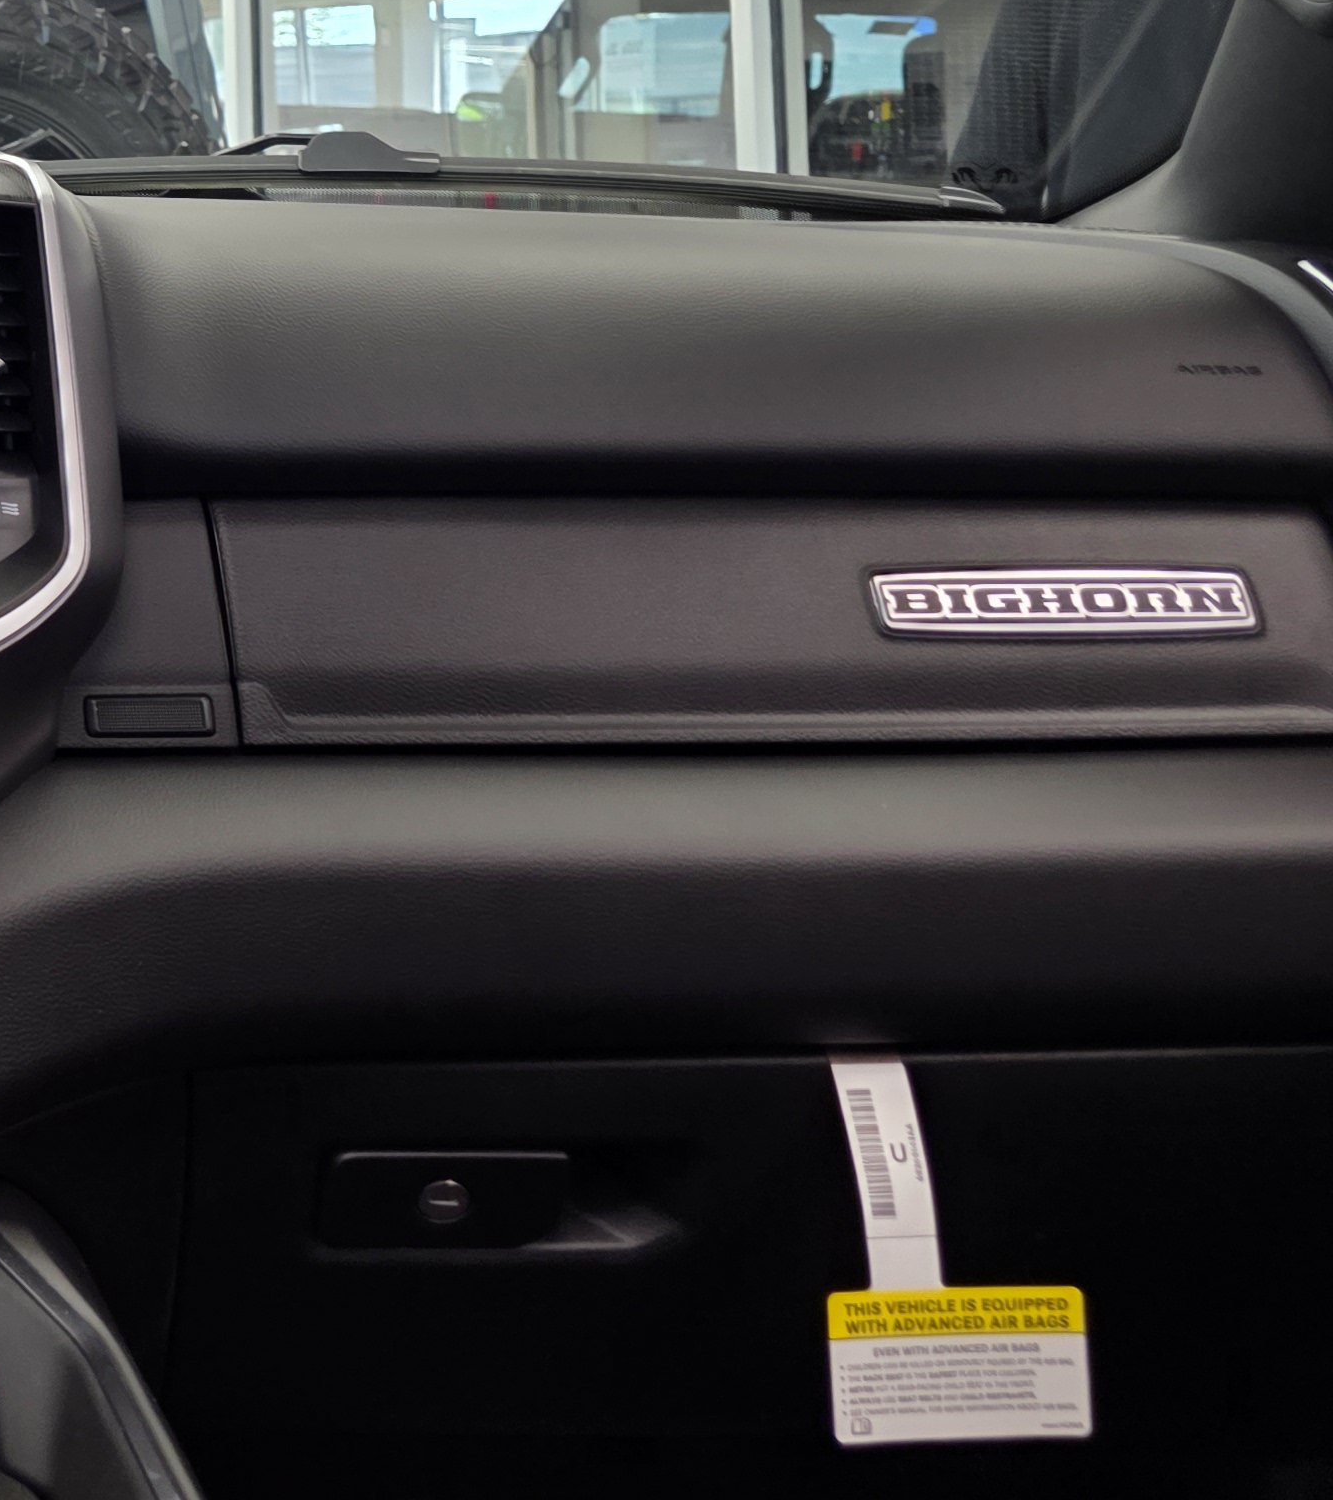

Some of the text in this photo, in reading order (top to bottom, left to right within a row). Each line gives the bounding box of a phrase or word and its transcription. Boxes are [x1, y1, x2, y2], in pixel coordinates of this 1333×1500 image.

[882, 583, 1251, 618] BIGHORN
[844, 1297, 1069, 1317] THIS VEHICLE IS EQUIPPED
[845, 1315, 1070, 1334] WITH ADVANCED AIR BAGS
[873, 1342, 1040, 1357] EVEN WITH ADVANCED AIR BAGS
